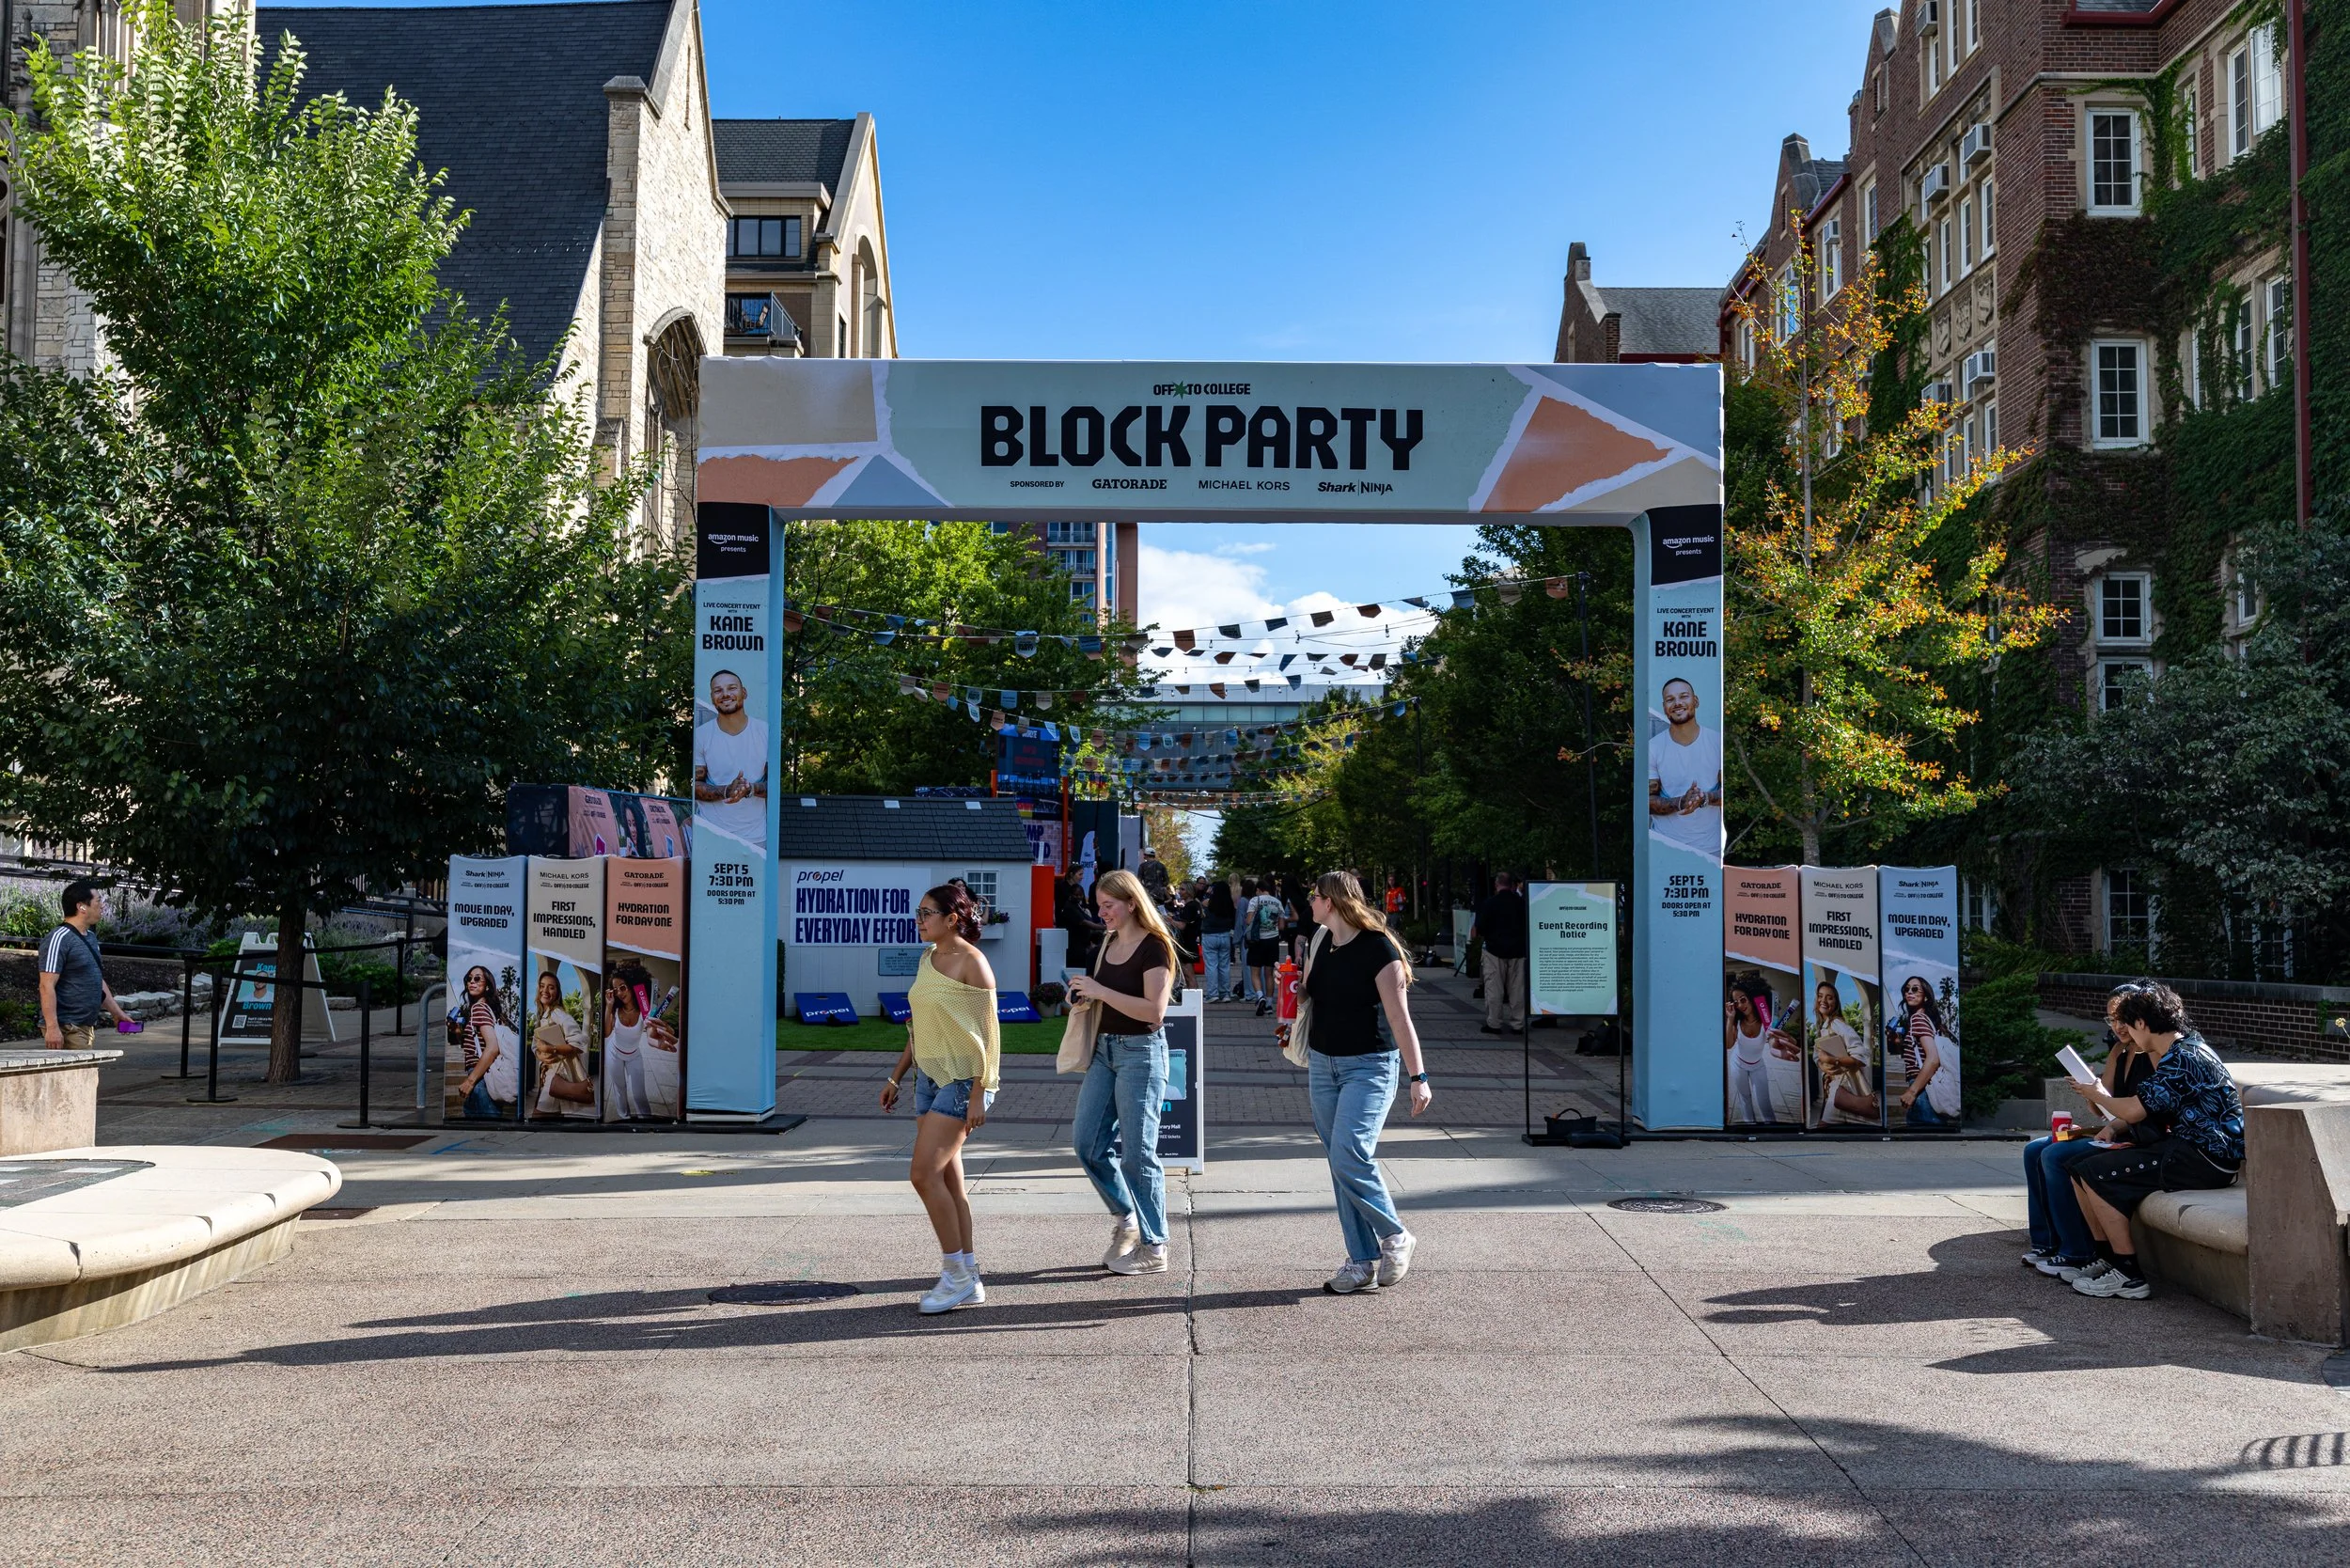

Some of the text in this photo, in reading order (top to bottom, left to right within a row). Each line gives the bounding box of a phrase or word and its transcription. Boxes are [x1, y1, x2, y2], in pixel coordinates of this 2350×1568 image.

[1152, 383, 1251, 396] OFF TO COLLEGE
[980, 404, 1424, 471] BLOCK PARTY
[1010, 480, 1054, 489] SPONSORED
[1055, 480, 1065, 489] BY
[1091, 478, 1167, 490] GATORADE
[1198, 479, 1253, 491] MICHAEL
[1257, 480, 1291, 492] KORS
[708, 533, 759, 543] amazon music
[1663, 534, 1715, 545] amazon music
[1675, 548, 1701, 557] presents
[710, 615, 754, 632] KANE
[1663, 620, 1707, 638] KANE
[702, 634, 764, 651] BROWN
[1654, 640, 1717, 658] BROWN
[714, 863, 749, 875] SEPT 5
[709, 875, 754, 886] 7:30 PM
[796, 870, 844, 884] propel
[1669, 875, 1704, 886] SEPT 5
[1813, 881, 1843, 889] MICHAEL
[1664, 887, 1709, 899] 7:30 PM
[552, 901, 576, 912] FIRST
[796, 887, 910, 914] HYDRATION FOR
[455, 902, 515, 917] MOVE IN DAY,
[618, 902, 669, 914] HYDRATION
[533, 913, 596, 928] IMPRESSIONS,
[616, 915, 672, 927] FOR DAY ONE
[1735, 913, 1787, 926] HYDRATION
[1826, 911, 1851, 922] FIRST
[1888, 914, 1950, 928] MOVE IN DAY,
[461, 917, 508, 929] UPGRADED
[1539, 921, 1608, 932] Event Recording
[542, 927, 586, 939] HANDLED
[795, 917, 871, 944] EVERYDAY
[1560, 931, 1587, 939] Notice
[1734, 925, 1790, 940] FOR DAY ONE
[1809, 923, 1872, 939] IMPRESSIONS,
[1895, 926, 1944, 939] UPGRADED
[1819, 937, 1862, 950] HANDLED
[806, 1007, 850, 1017] propel
[997, 1006, 1030, 1014] ropel
